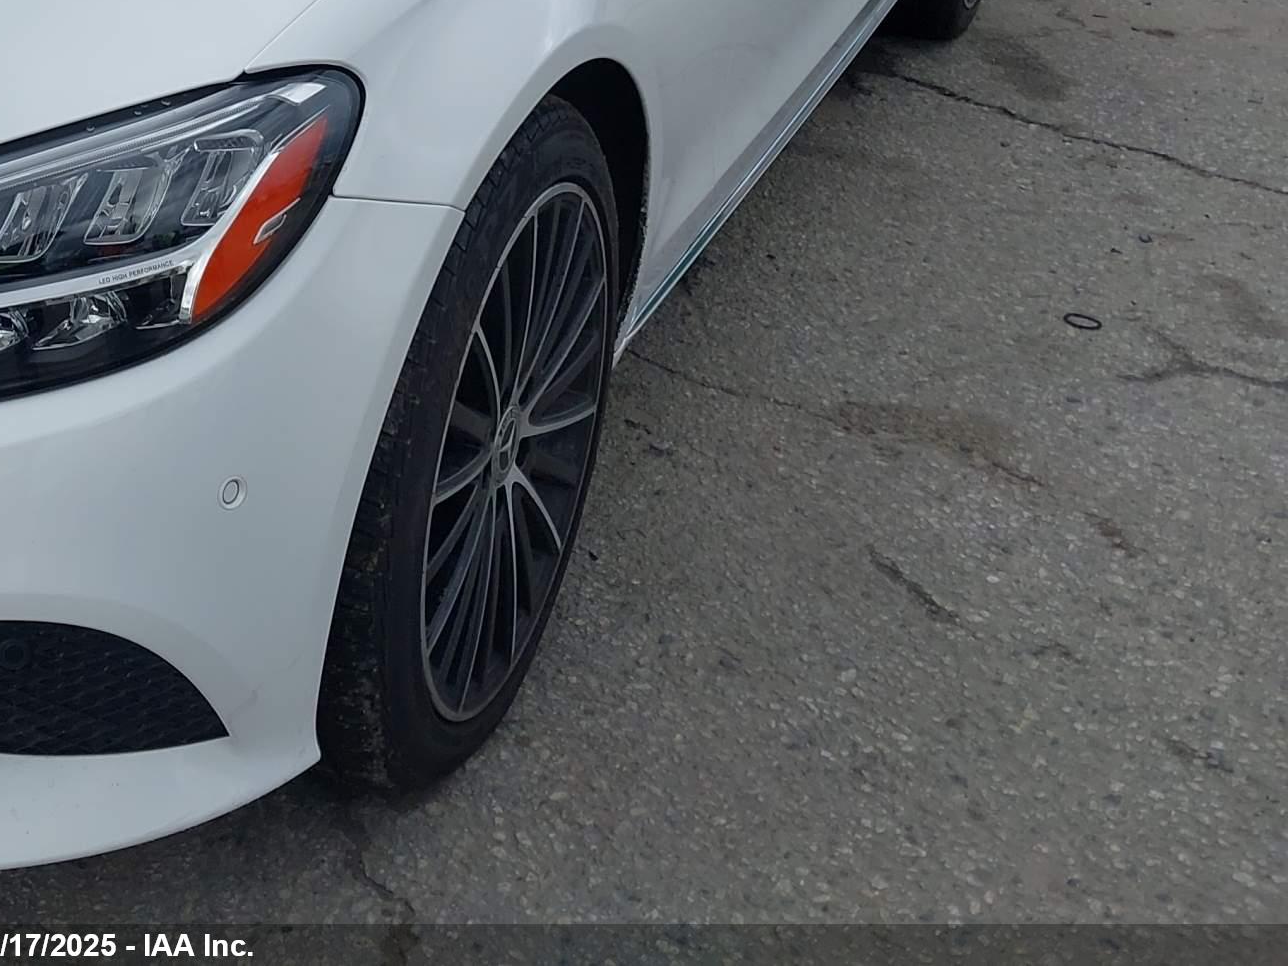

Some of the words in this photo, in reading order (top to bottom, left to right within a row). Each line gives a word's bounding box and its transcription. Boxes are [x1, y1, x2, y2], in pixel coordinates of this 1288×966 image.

[98, 276, 111, 285] LED
[112, 273, 128, 282] HIGH
[128, 260, 174, 278] PERFORMANCE
